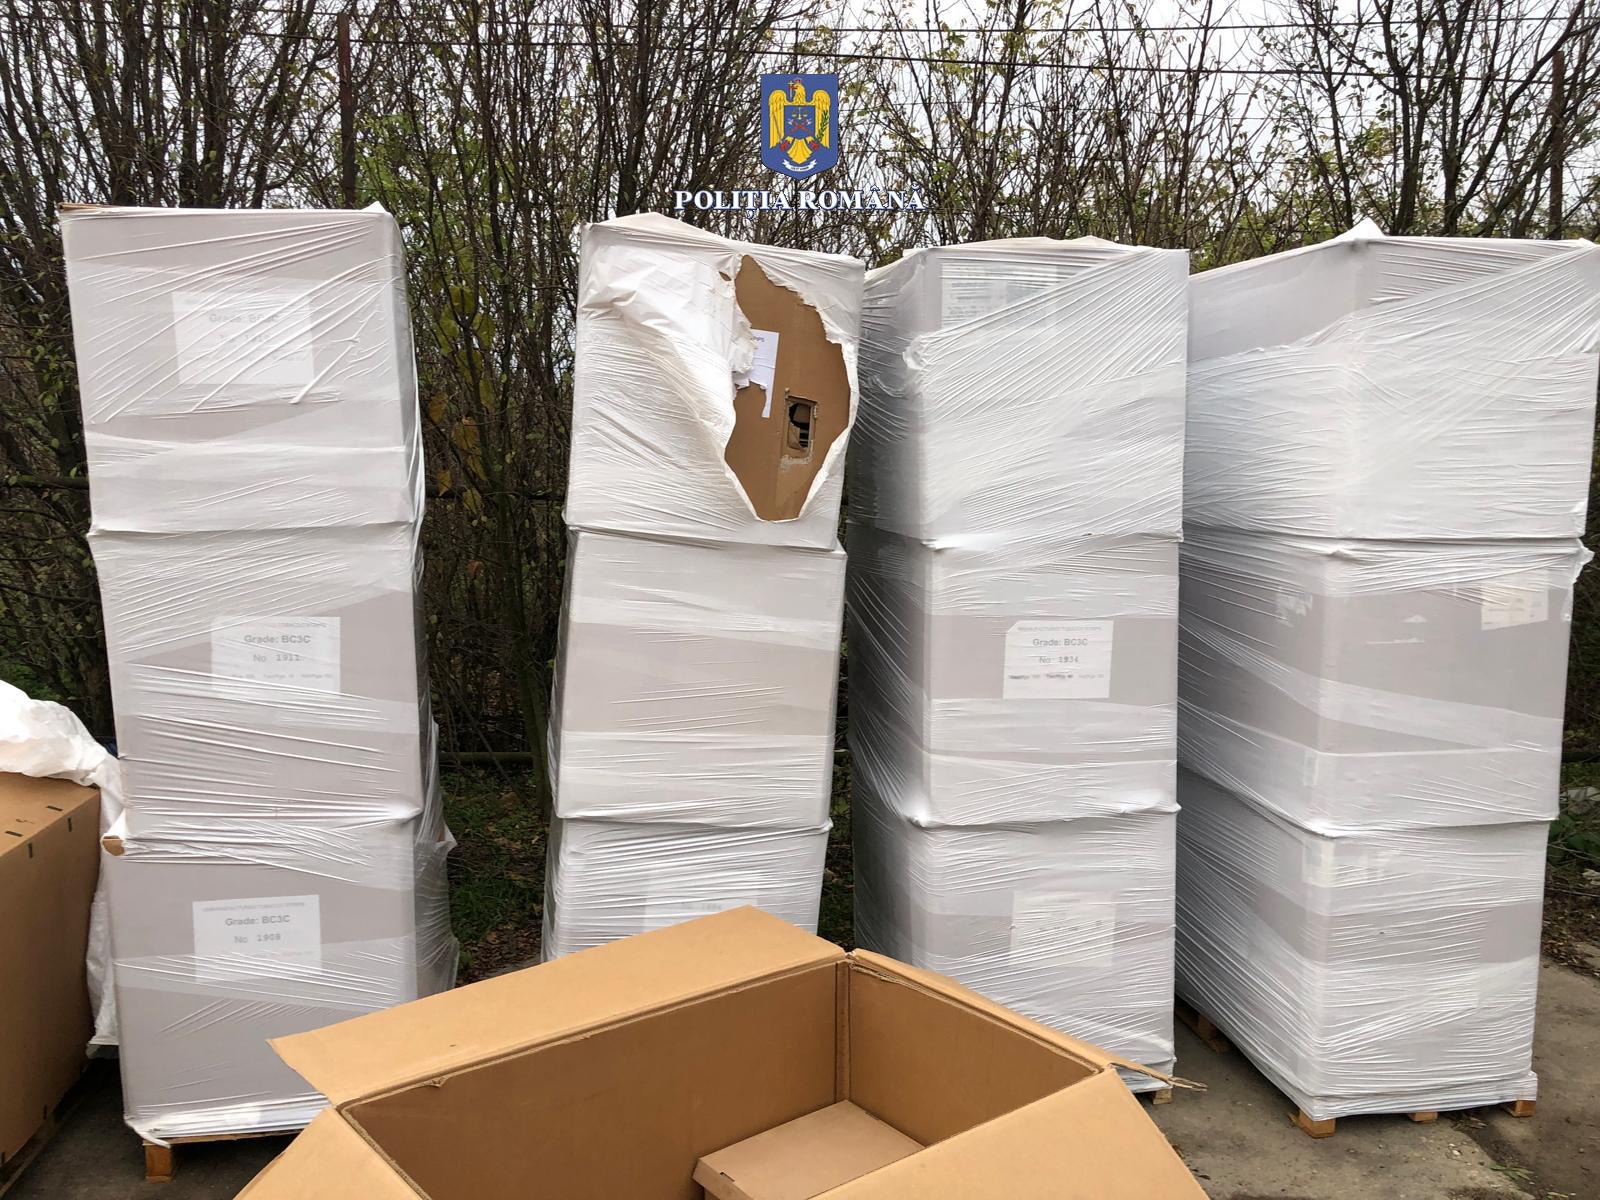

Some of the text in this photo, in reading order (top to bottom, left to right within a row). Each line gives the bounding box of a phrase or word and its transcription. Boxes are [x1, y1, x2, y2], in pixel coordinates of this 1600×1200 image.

[244, 634, 312, 644] Grade: BC3C
[1032, 637, 1089, 647] Grade: BC3C
[225, 914, 291, 926] Grade: BC3C
